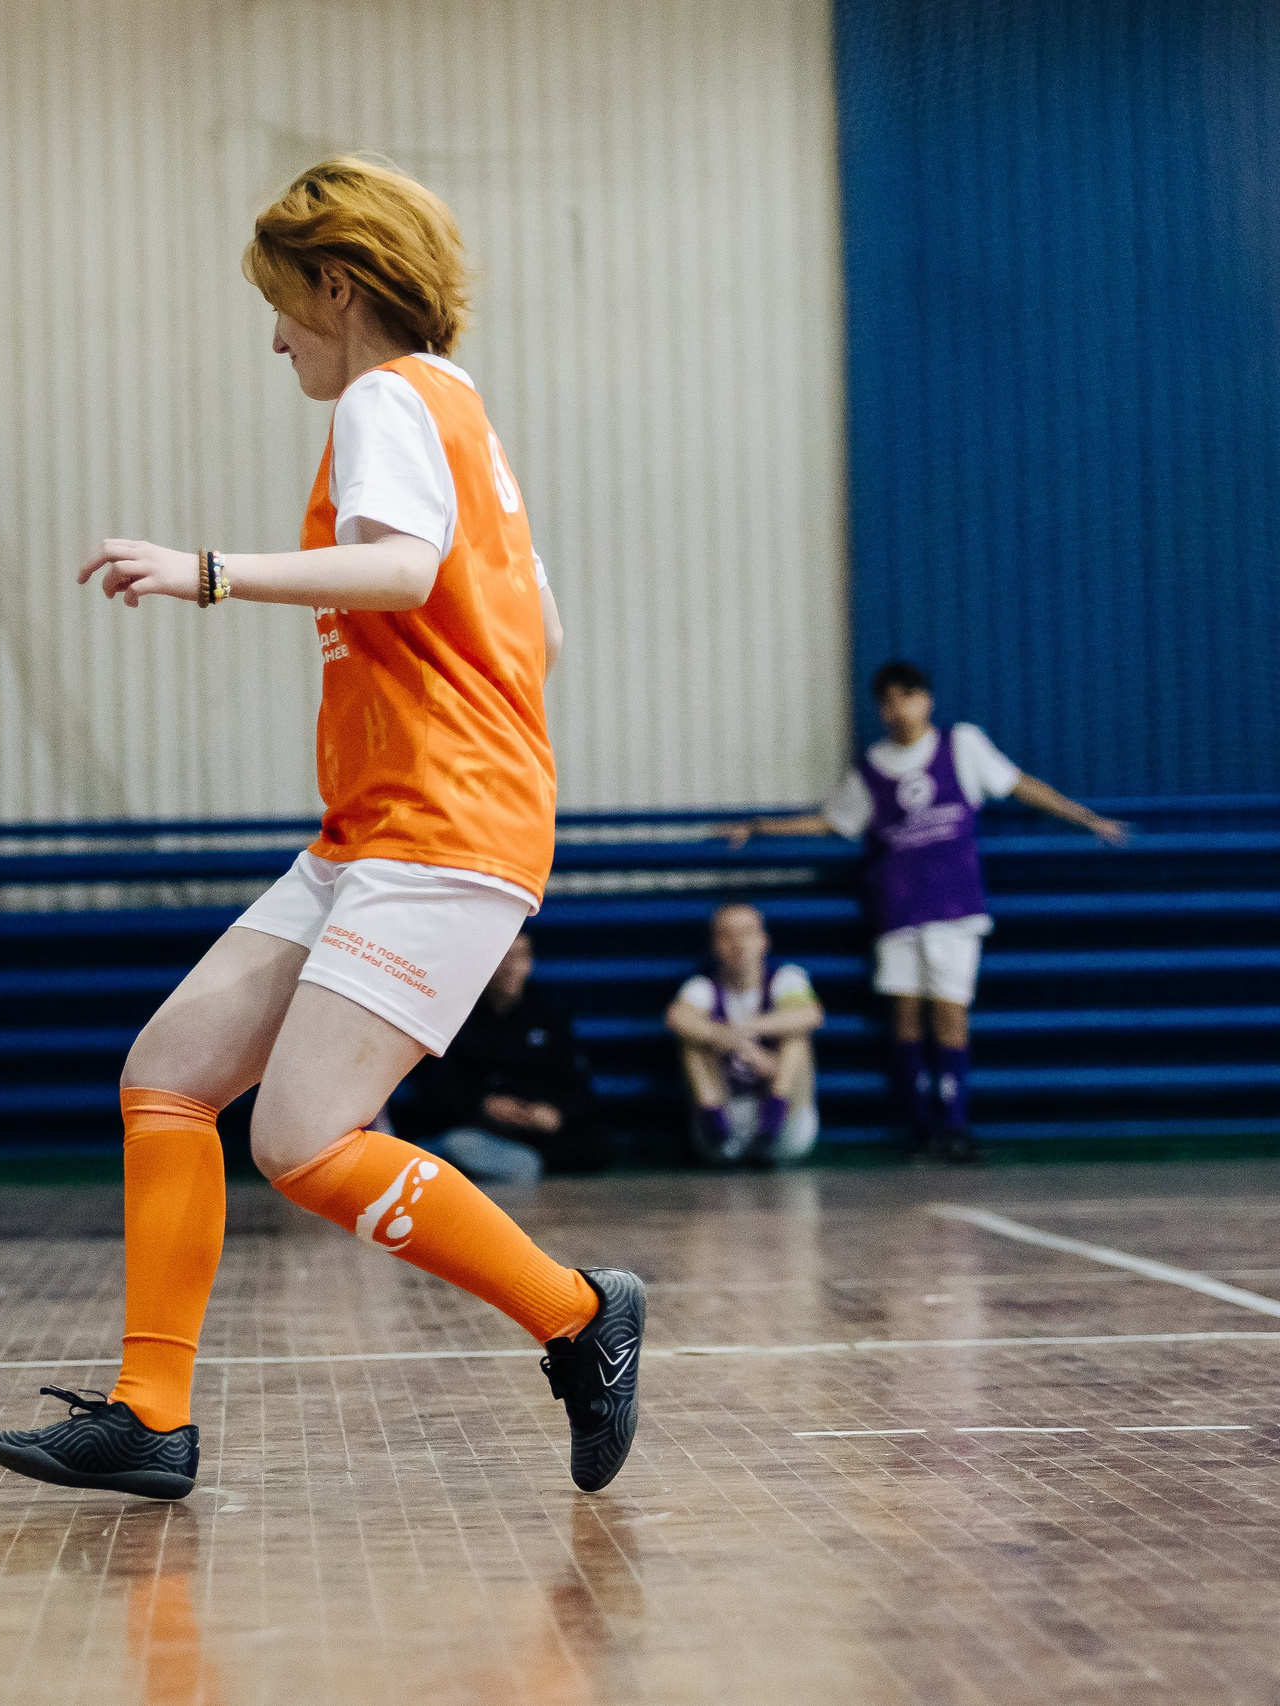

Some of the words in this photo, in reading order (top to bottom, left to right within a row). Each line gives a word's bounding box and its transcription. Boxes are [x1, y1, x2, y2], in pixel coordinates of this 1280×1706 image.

[321, 935, 360, 956] ВМЕСТЕ
[360, 951, 383, 968] МЫ
[384, 964, 438, 999] СИЛЬНЕЕ!
[326, 924, 365, 948] ВПЕРЁД
[366, 941, 377, 951] К
[377, 947, 428, 979] ПОБЕДЕ!
